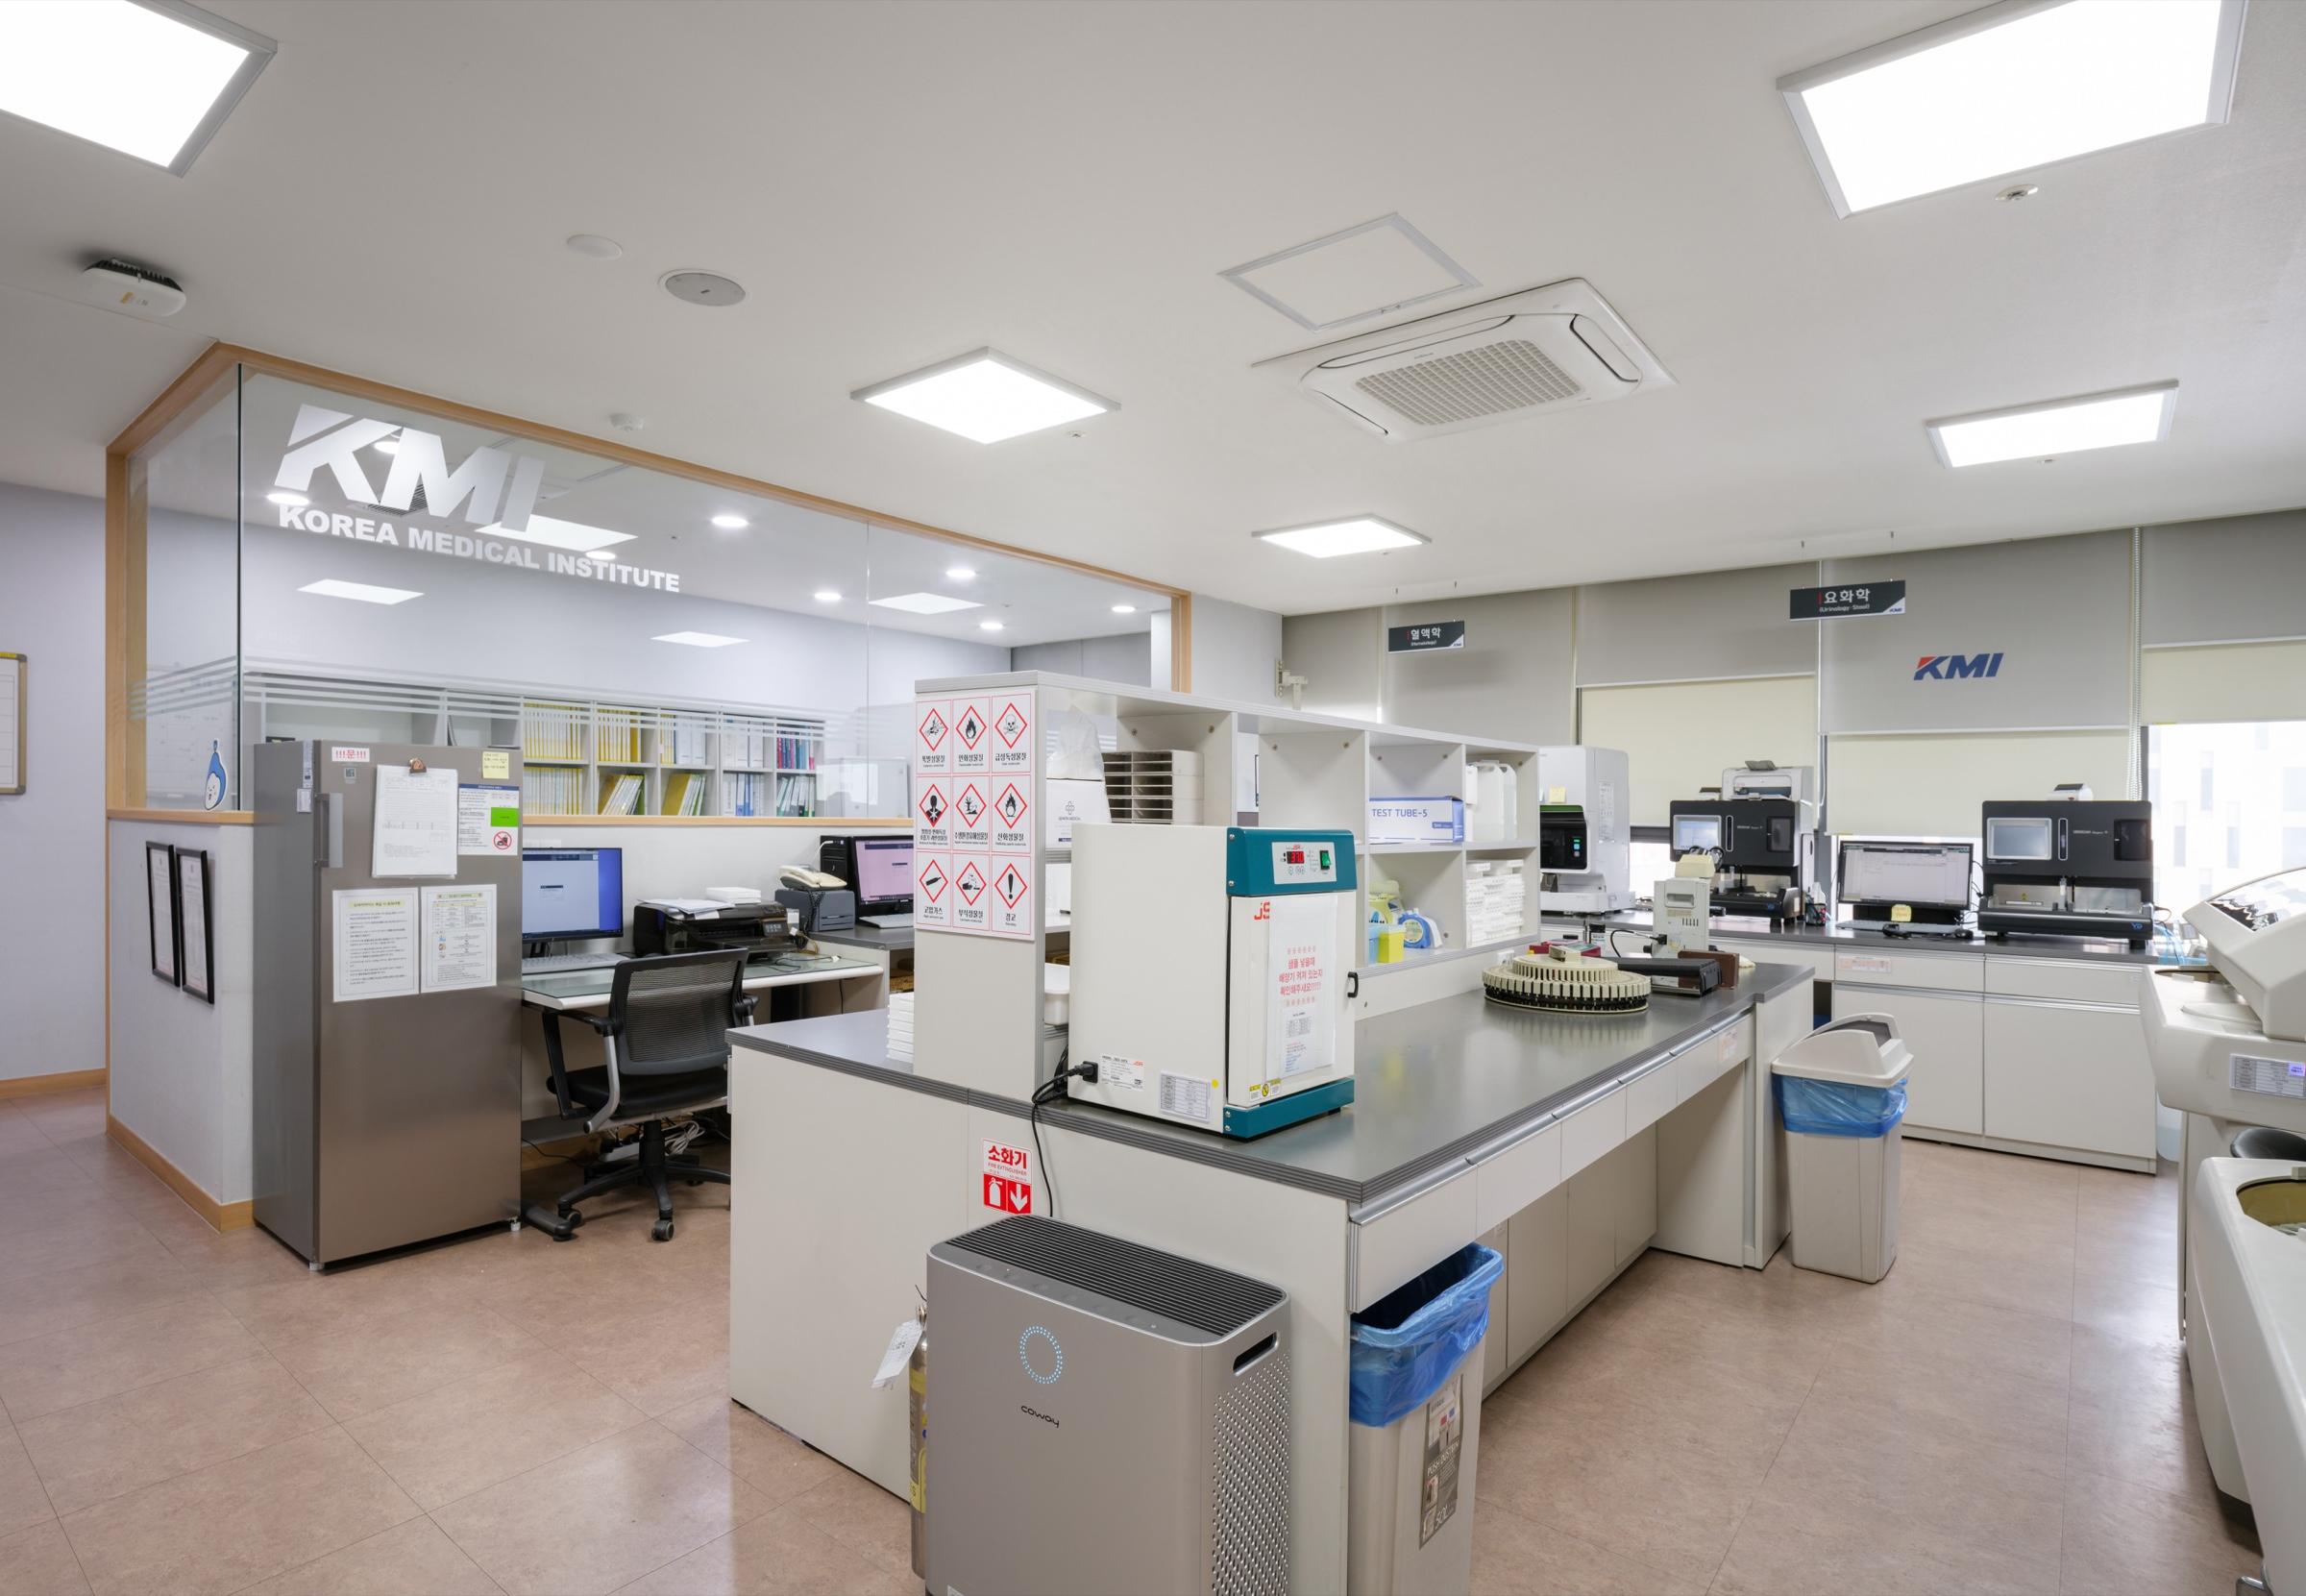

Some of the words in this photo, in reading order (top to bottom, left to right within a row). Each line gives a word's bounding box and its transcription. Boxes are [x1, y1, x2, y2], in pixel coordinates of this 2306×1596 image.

[275, 404, 545, 532] KMI
[279, 505, 399, 546] KOREA
[408, 528, 540, 570] MEDICAL
[548, 552, 680, 593] INSTITUTE
[1824, 588, 1871, 603] 요화학
[1411, 626, 1441, 640] 혈액학
[1913, 652, 2003, 680] KMI
[924, 906, 943, 915] 고압가스
[1005, 913, 1017, 921] 경고
[988, 1144, 1027, 1169] 소화기
